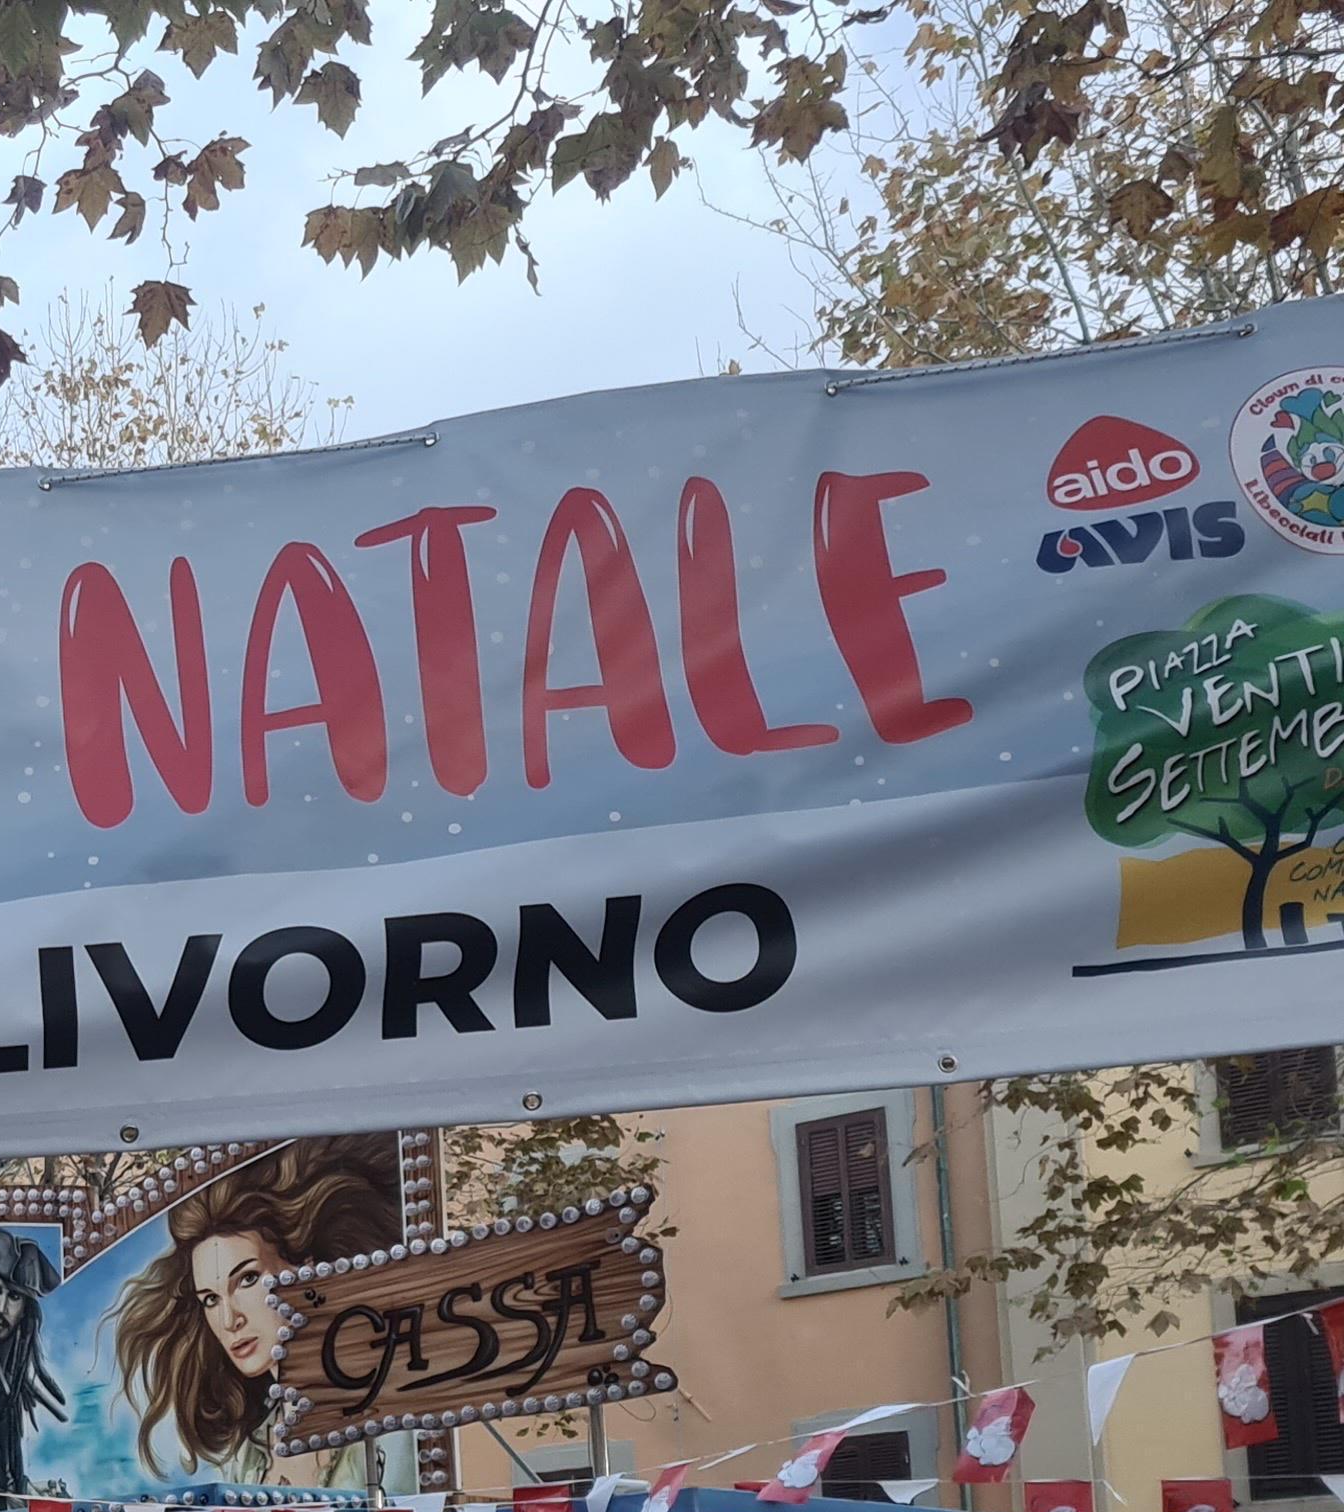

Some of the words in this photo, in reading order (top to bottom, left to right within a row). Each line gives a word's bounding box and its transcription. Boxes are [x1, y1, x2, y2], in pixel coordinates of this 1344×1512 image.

[1249, 382, 1300, 417] Clown
[1052, 443, 1193, 504] aido
[1035, 500, 1246, 574] AVIS
[59, 470, 974, 829] NATALE
[1108, 618, 1259, 712] PIAZZA
[1134, 636, 1344, 738] VENTI
[321, 1259, 606, 1417] CASSA
